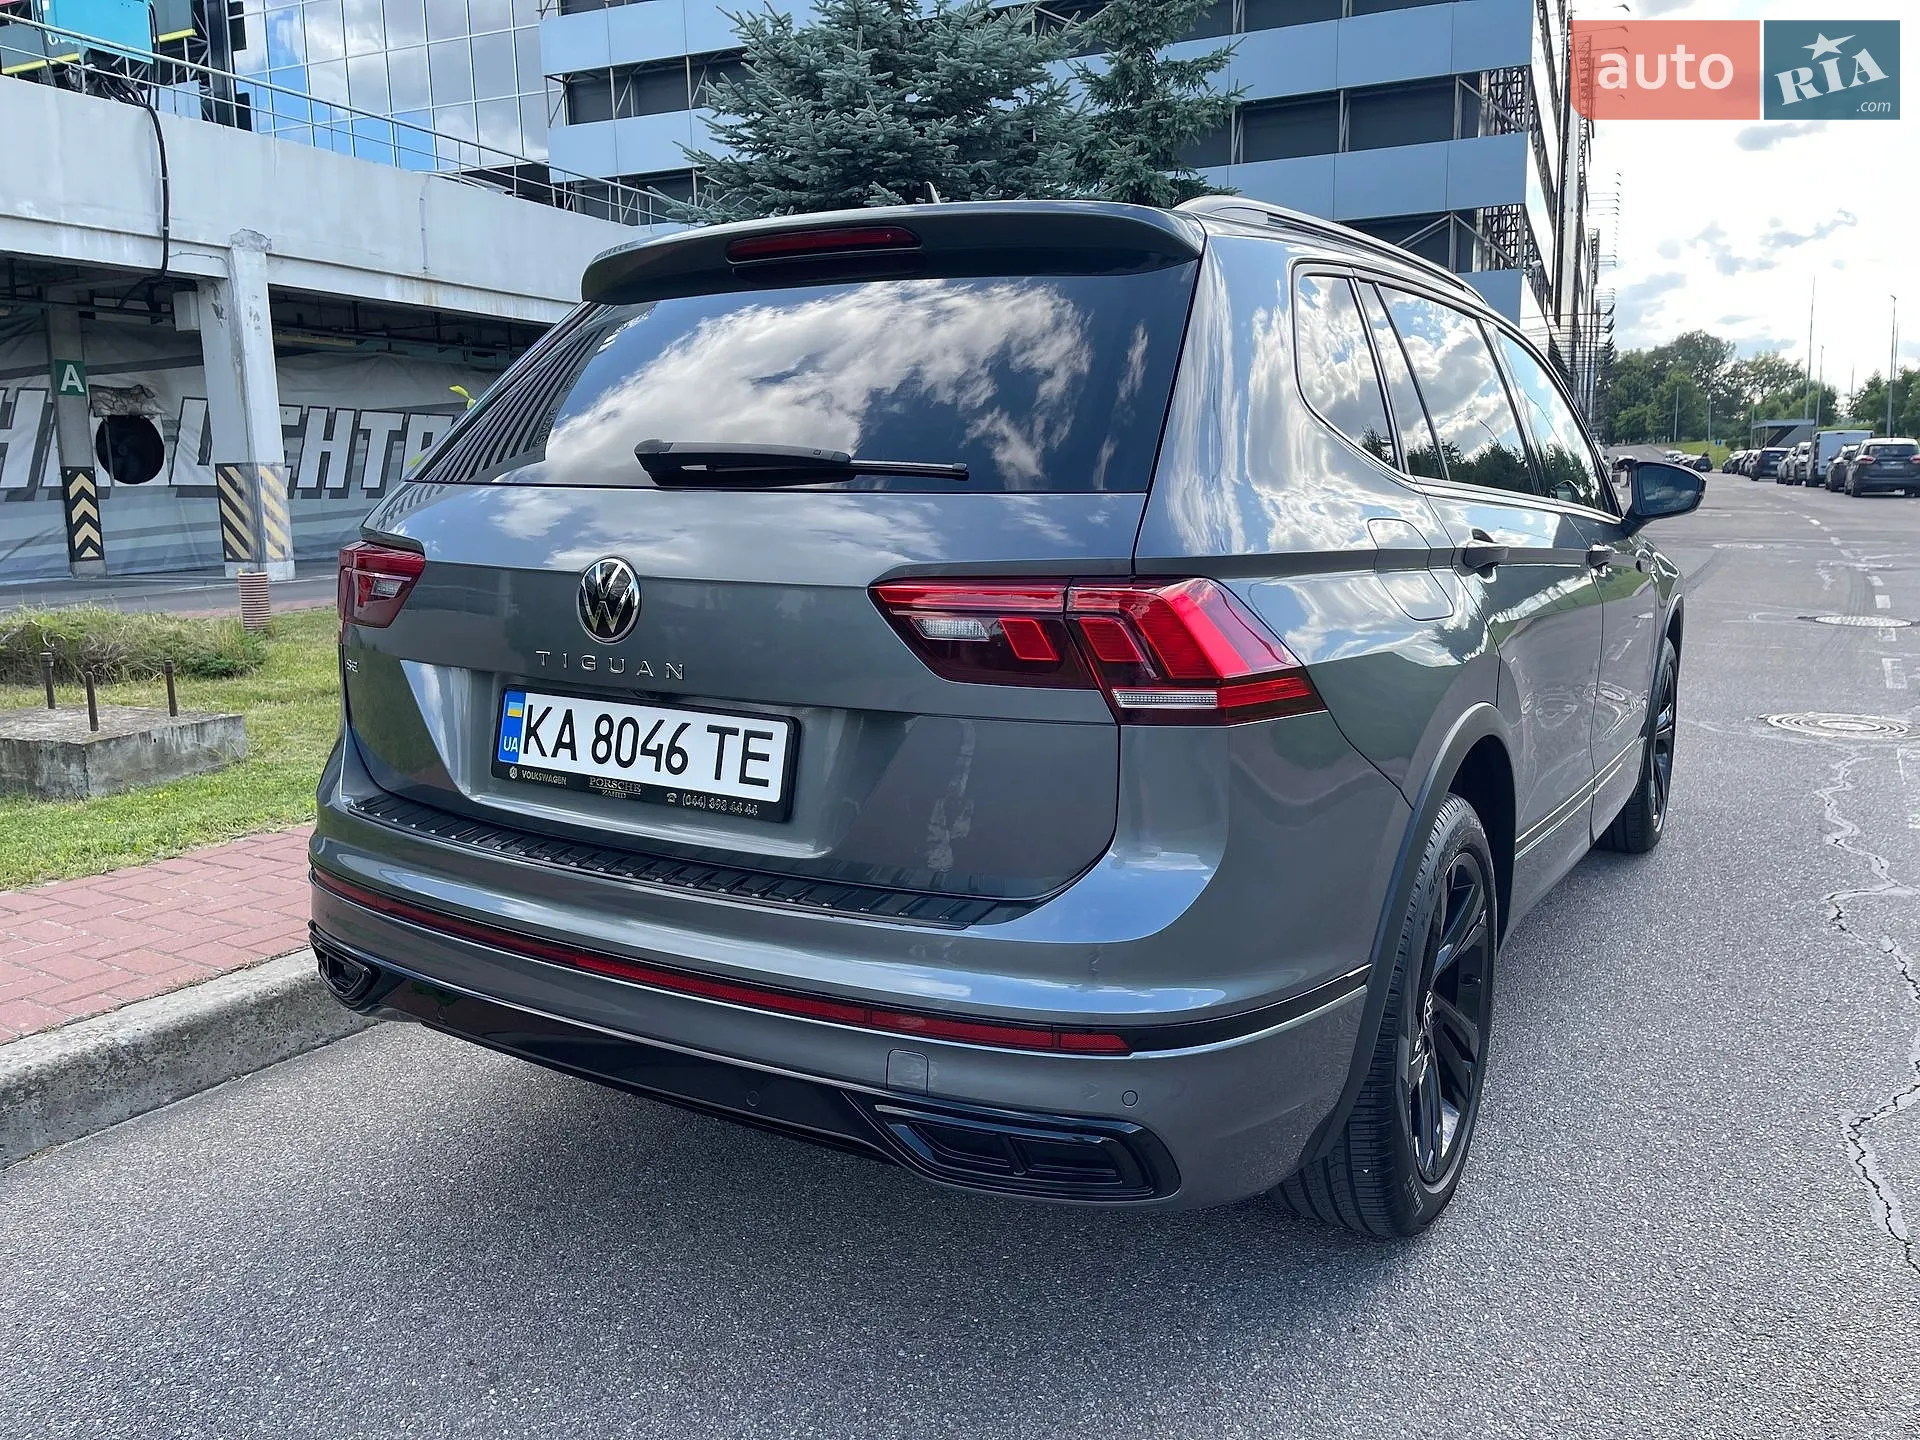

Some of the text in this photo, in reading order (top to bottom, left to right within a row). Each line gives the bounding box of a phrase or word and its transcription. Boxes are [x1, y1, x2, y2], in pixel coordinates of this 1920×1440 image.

[61, 363, 85, 392] A
[535, 650, 685, 680] TIGUAN
[503, 736, 519, 752] UA
[523, 704, 774, 788] KA 8046 TE
[521, 769, 567, 786] VOLKSWAGEN
[589, 776, 642, 793] PORSCHE
